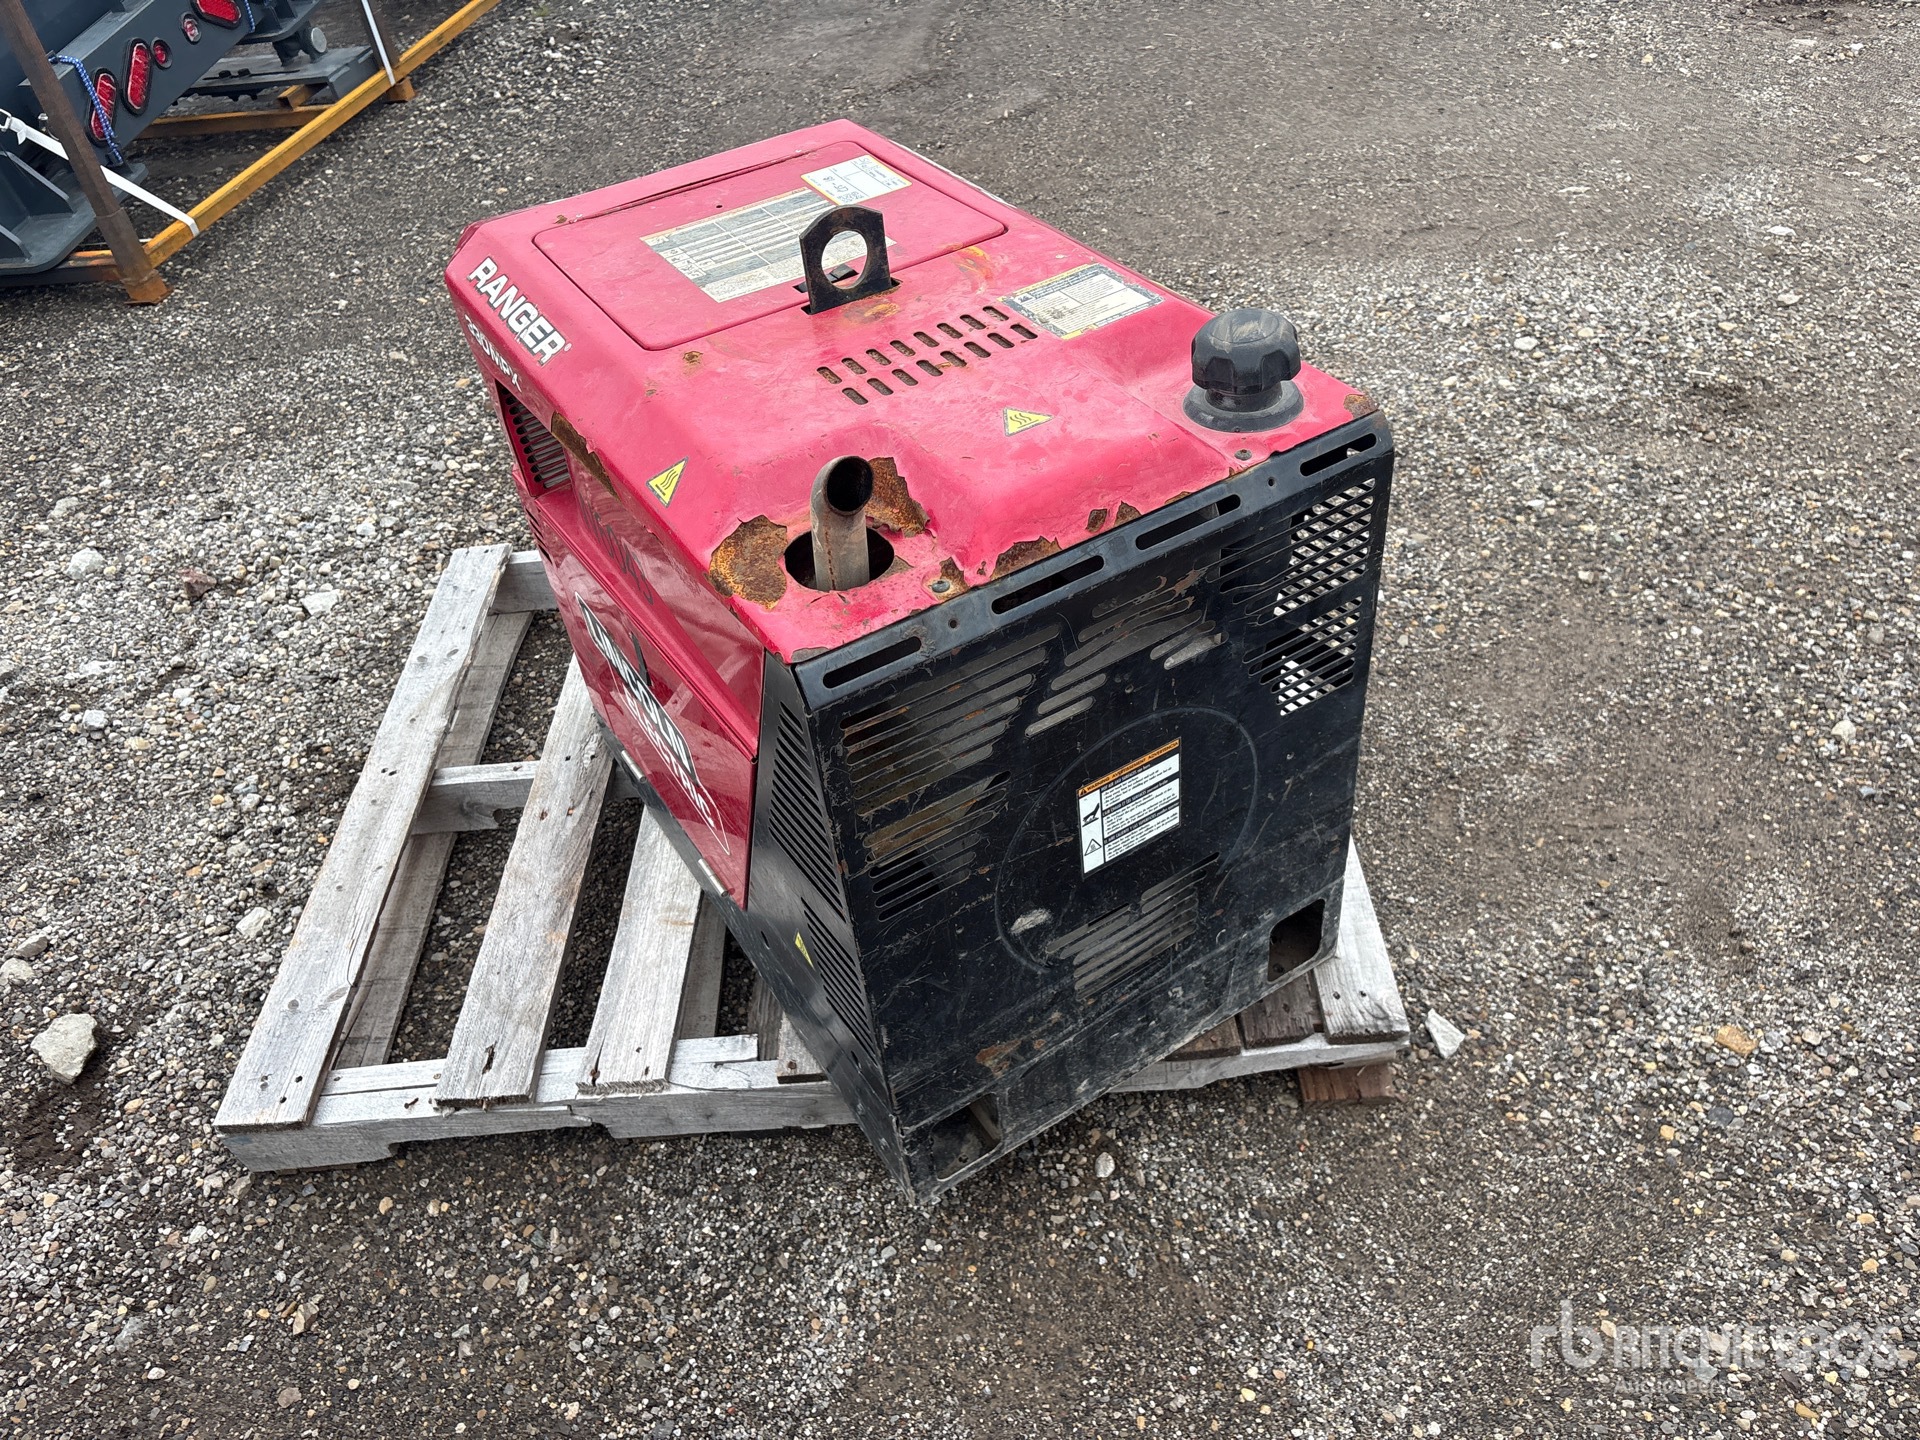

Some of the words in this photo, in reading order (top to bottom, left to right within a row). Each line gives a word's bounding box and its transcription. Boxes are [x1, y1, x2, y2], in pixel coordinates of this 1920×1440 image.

[585, 607, 692, 774] LINCOLN
[623, 684, 715, 828] ELECTRIC
[1087, 775, 1110, 791] WARNING
